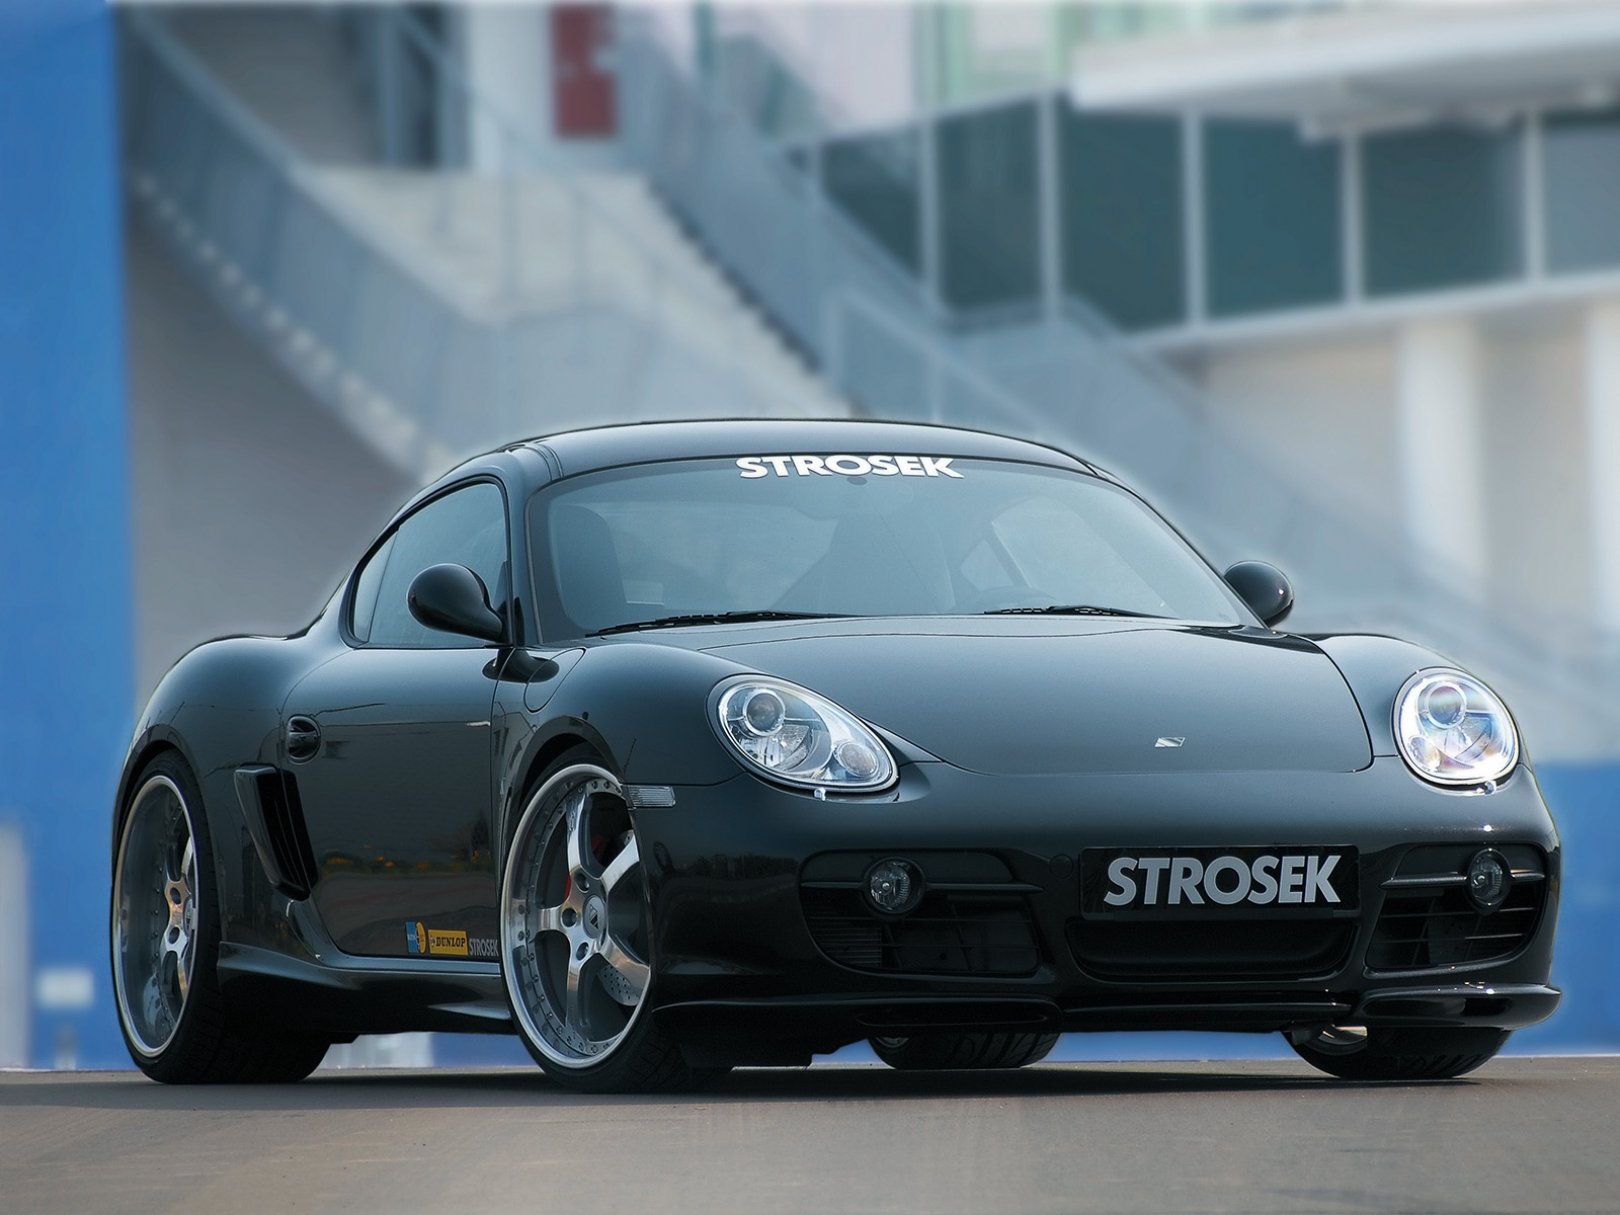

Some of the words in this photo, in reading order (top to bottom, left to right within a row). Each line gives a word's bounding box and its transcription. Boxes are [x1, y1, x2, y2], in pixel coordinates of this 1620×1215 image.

[735, 454, 965, 479] STROSEK
[1103, 855, 1342, 906] STROSEK
[435, 936, 466, 948] DUNLOP
[468, 938, 499, 957] STROSEK
